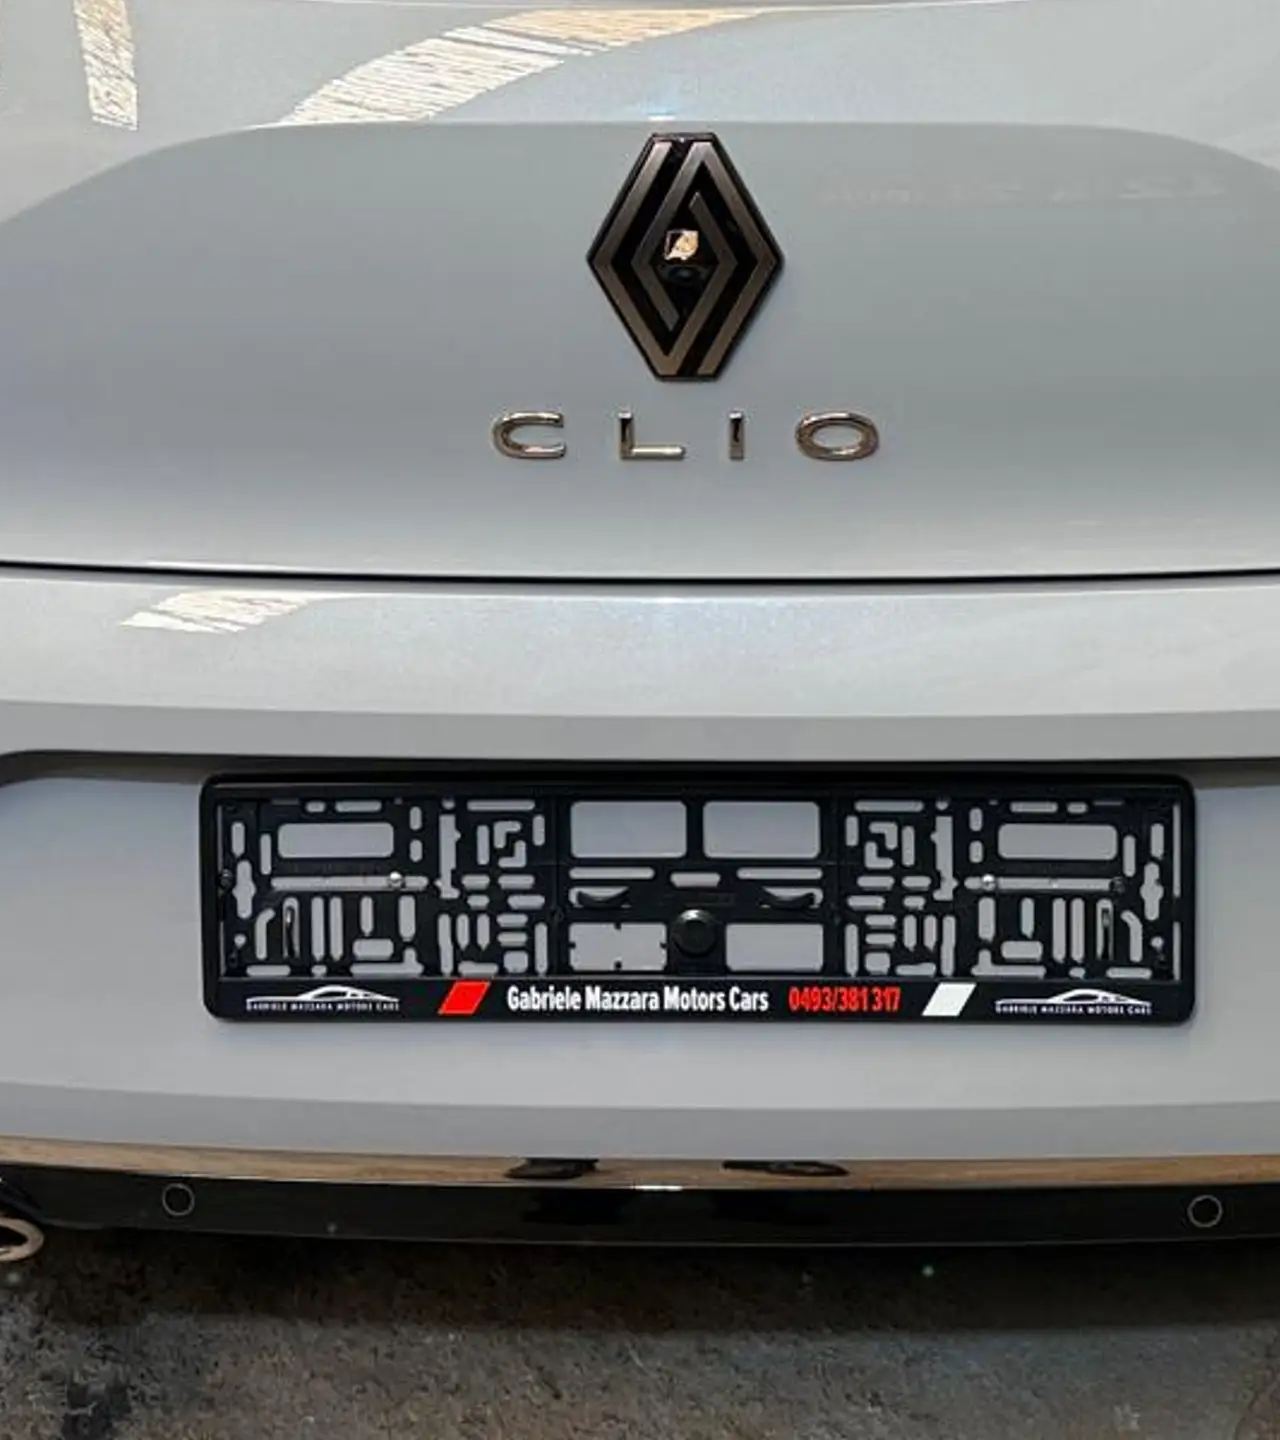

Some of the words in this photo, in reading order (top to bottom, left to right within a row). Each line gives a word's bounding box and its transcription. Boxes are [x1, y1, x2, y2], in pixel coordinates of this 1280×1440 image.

[492, 410, 880, 460] CLIO
[506, 984, 581, 1011] Gabriele
[584, 984, 659, 1010] Mazzara
[663, 984, 725, 1010] Motors
[729, 985, 769, 1010] Cars
[788, 985, 868, 1013] 0493/381
[871, 985, 902, 1012] 317
